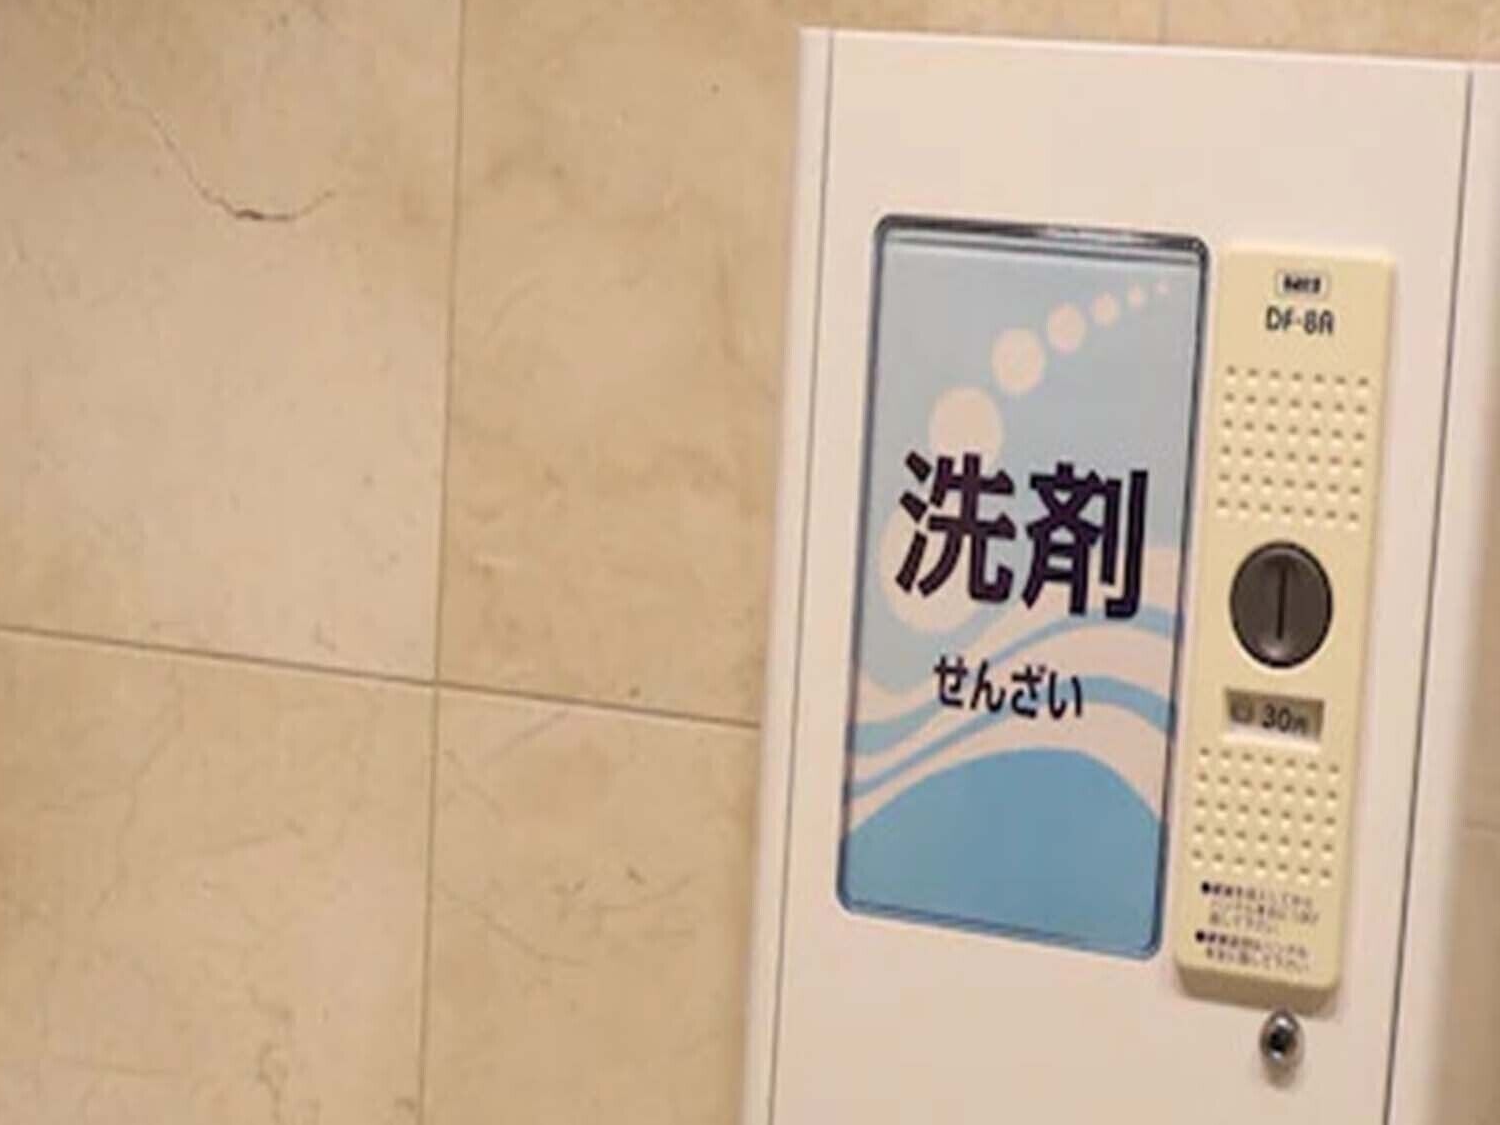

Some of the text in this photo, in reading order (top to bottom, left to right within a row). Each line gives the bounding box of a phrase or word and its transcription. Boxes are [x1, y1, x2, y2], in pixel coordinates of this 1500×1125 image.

[1265, 305, 1335, 335] DF-8A
[895, 451, 1149, 620] 洗剤
[933, 655, 1084, 721] せんざい
